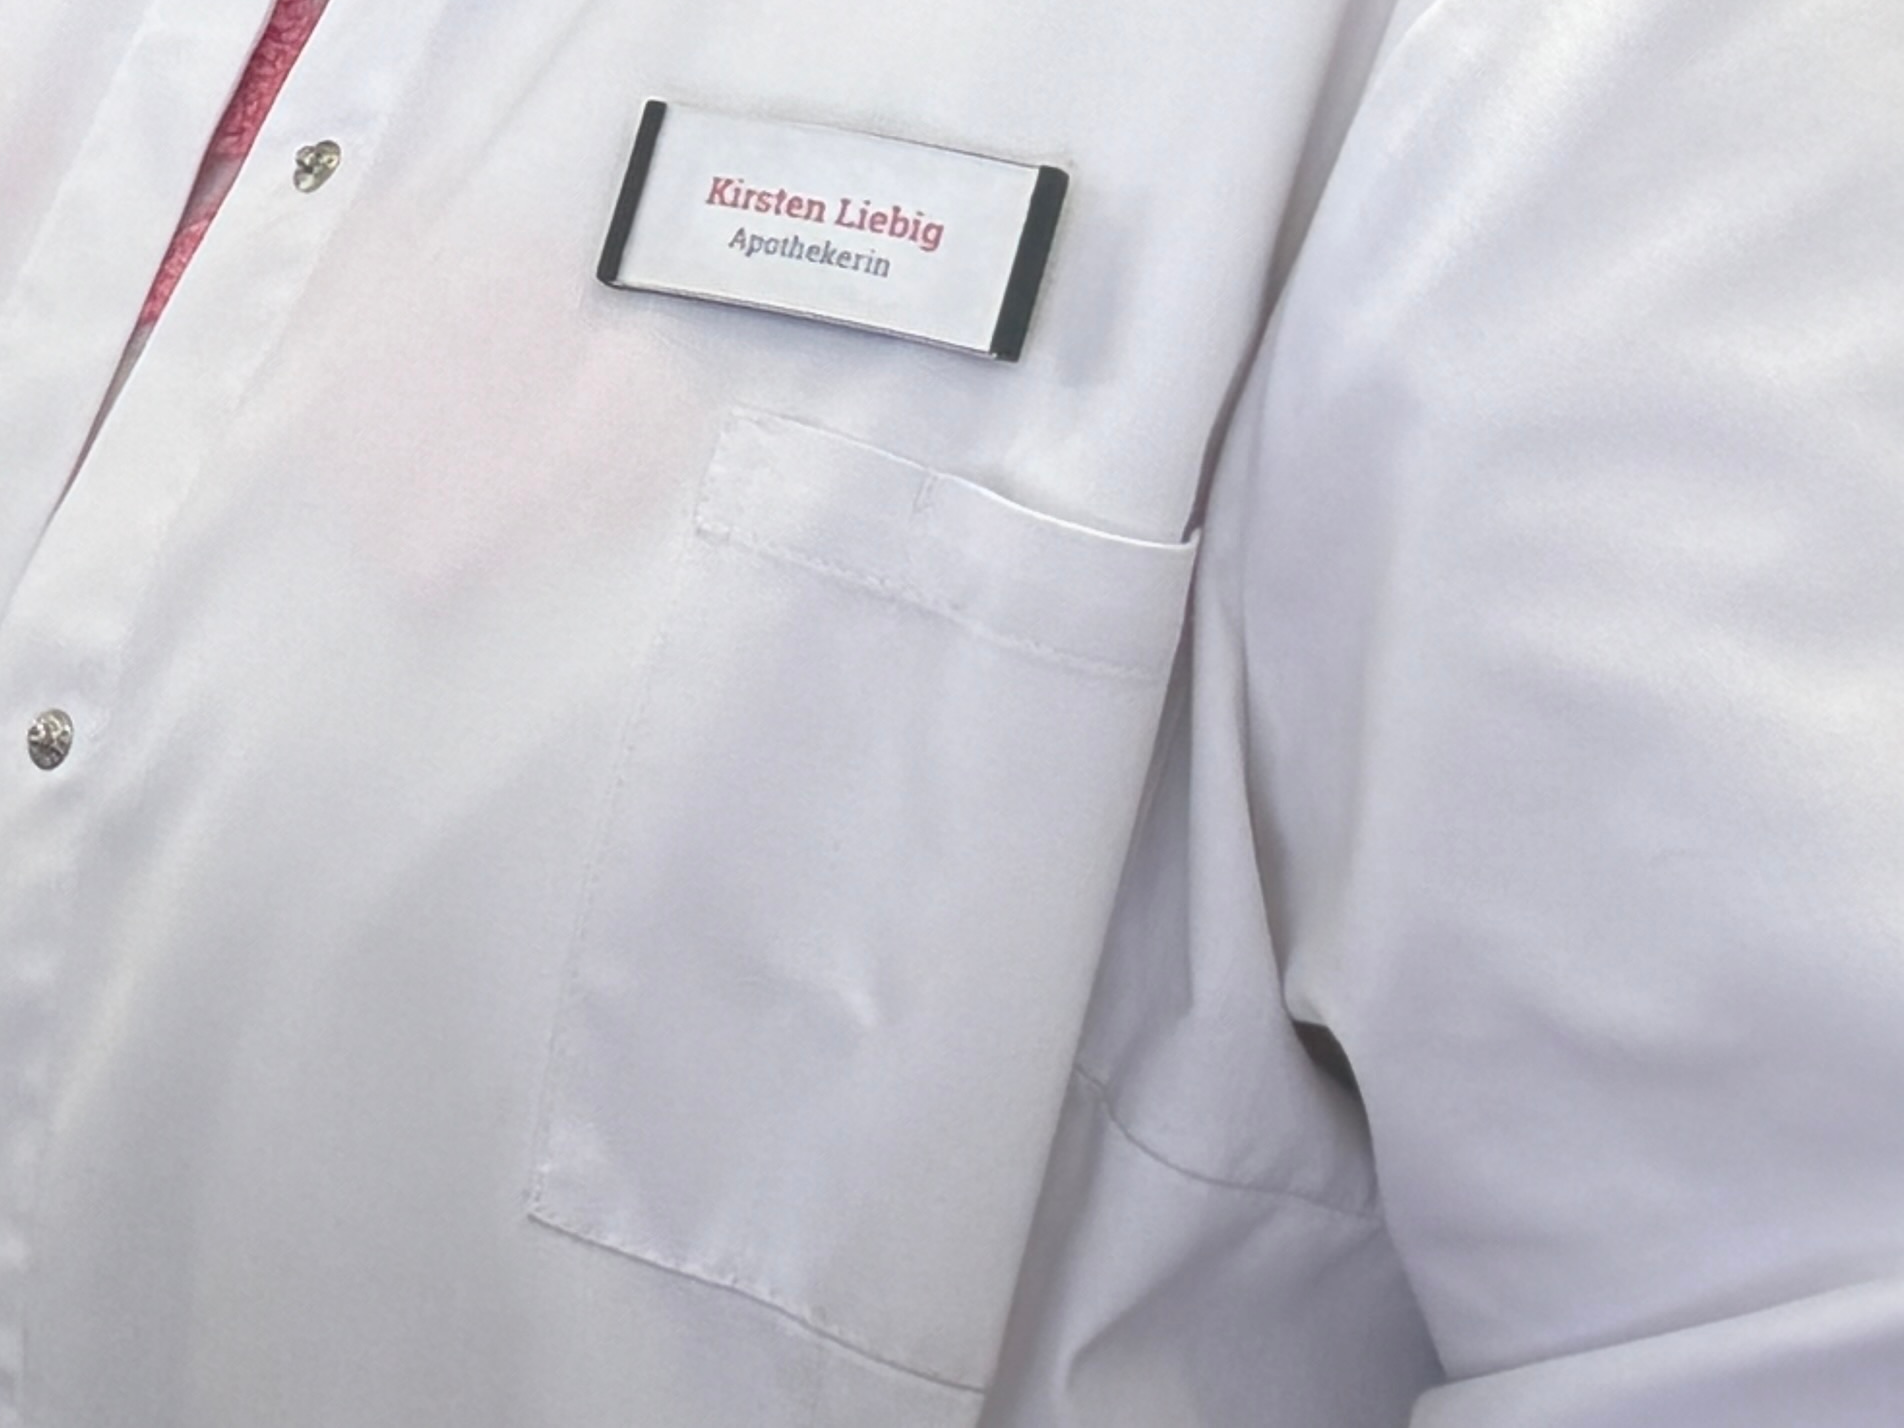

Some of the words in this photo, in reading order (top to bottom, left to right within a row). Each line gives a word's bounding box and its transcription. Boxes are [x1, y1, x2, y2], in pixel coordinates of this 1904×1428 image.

[705, 175, 826, 224] Kirsten
[834, 197, 946, 253] Liebig
[728, 226, 892, 279] Apothekerin
